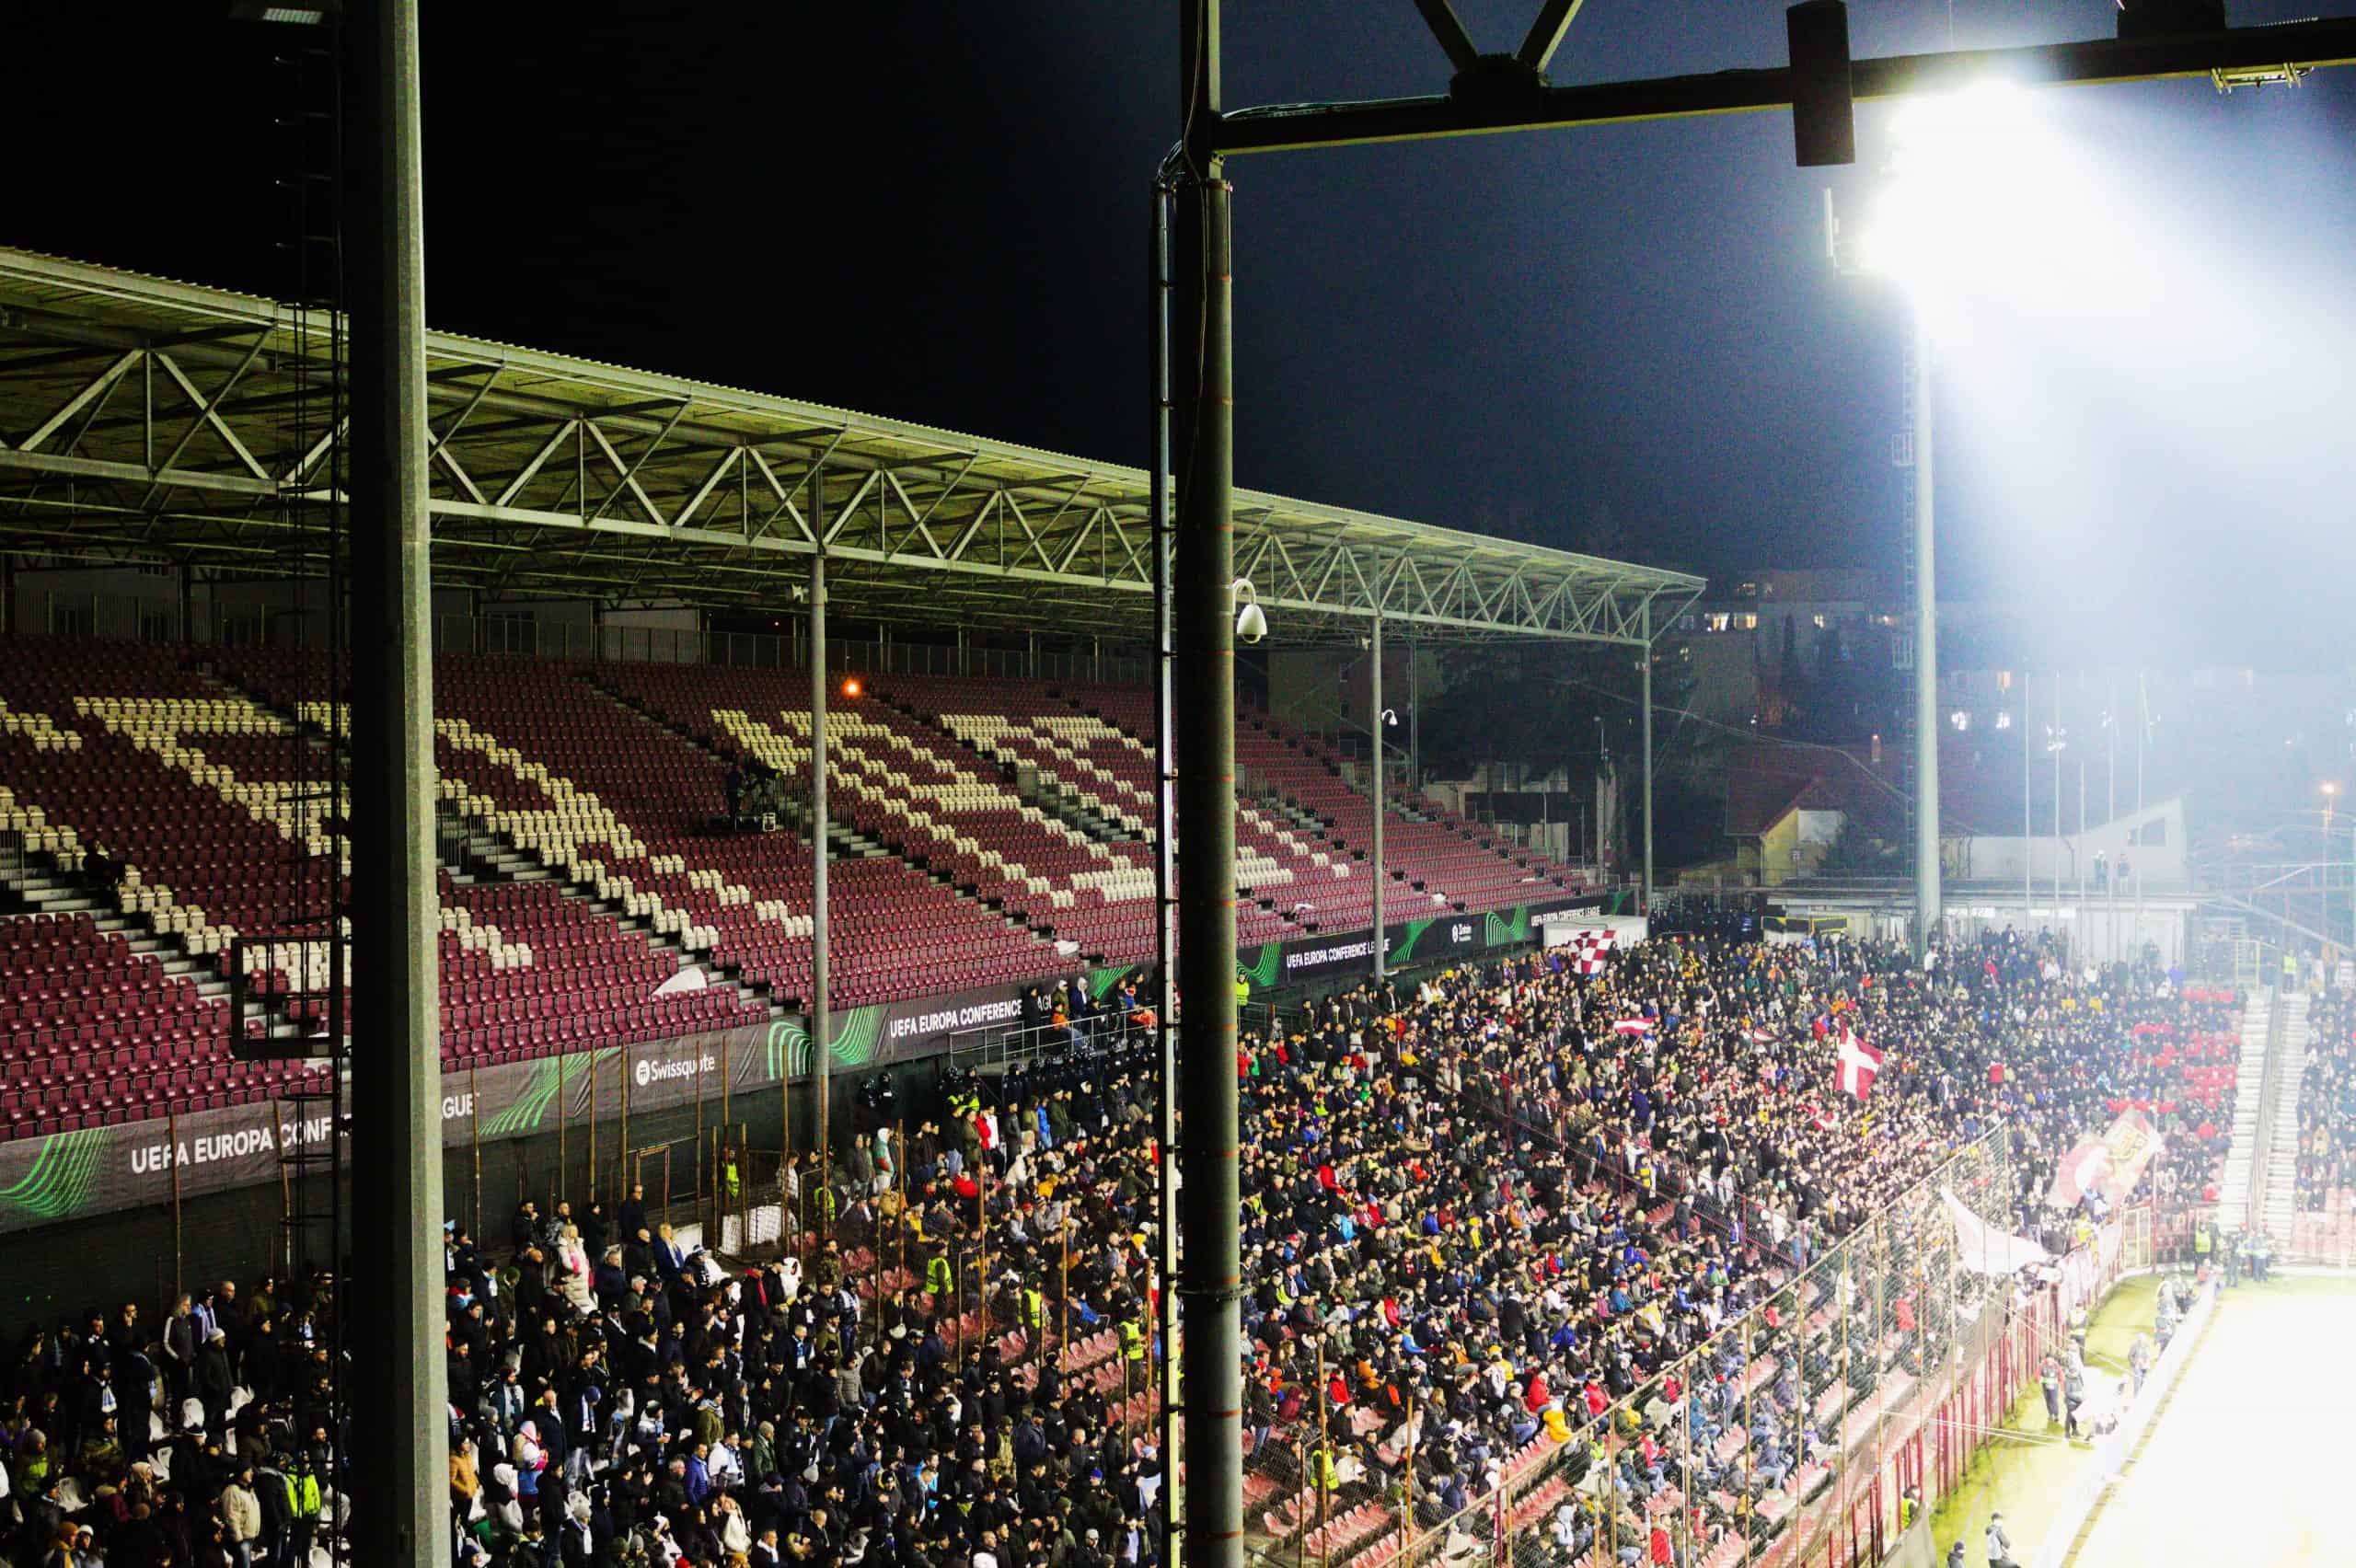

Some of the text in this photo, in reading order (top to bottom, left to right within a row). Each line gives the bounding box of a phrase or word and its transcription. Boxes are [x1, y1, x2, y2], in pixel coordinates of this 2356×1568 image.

[1287, 952, 1304, 968] UEFA
[1303, 949, 1327, 966] EUROPA
[1328, 941, 1368, 962] CONFERENCE
[890, 1016, 918, 1038] UEFA
[919, 1010, 959, 1033] EUROPA
[960, 998, 1022, 1025] CONFERENCE
[132, 1141, 190, 1174] UEFA
[194, 1126, 274, 1164] EUROPA
